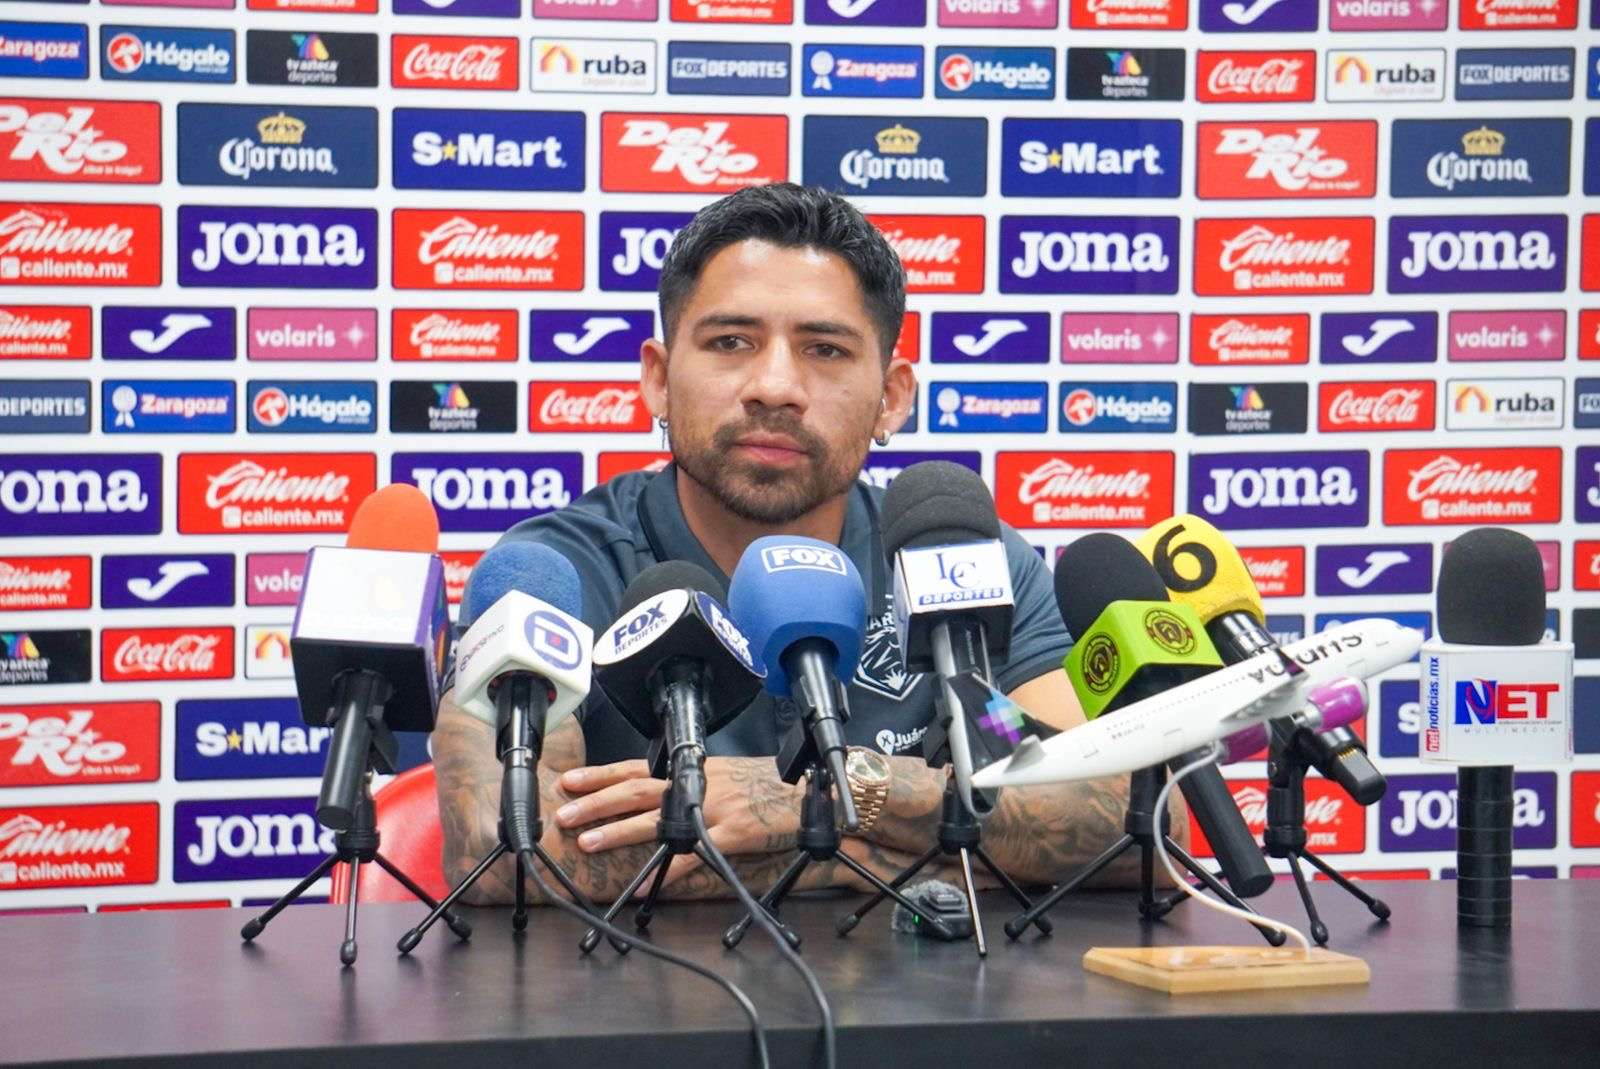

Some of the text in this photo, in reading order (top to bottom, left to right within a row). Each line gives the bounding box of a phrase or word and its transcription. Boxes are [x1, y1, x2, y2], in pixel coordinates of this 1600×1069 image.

[945, 0, 1021, 14] volaris
[1336, 0, 1410, 17] volaris
[144, 34, 229, 72] Hágalo
[584, 53, 646, 76] ruba
[287, 69, 337, 84] deportes
[707, 60, 787, 78] DEPORTES
[836, 59, 917, 83] Zaragoza
[973, 54, 1051, 90] Hágalo
[1375, 62, 1436, 84] ruba
[1494, 65, 1570, 83] DEPORTES
[617, 119, 731, 147] Del
[1215, 127, 1322, 155] Del
[218, 137, 338, 181] Corona
[839, 148, 950, 189] Corona
[1426, 151, 1533, 191] Corona
[417, 216, 560, 265] Caliente
[1219, 225, 1351, 272] Caliente
[21, 258, 128, 279] caliente.mx
[454, 264, 554, 284] caliente.mx
[1252, 271, 1344, 289] caliente.mx
[255, 324, 336, 348] volaris
[410, 313, 501, 346] Caliente
[1067, 328, 1142, 352] volaris
[1208, 319, 1294, 351] Caliente
[1455, 325, 1528, 349] volaris
[140, 394, 228, 419] Zaragoza
[289, 395, 371, 424] Hágalo
[962, 395, 1042, 418] Zaragoza
[1097, 396, 1172, 425] Hágalo
[1494, 391, 1555, 414] ruba
[428, 416, 477, 431] deportes
[1225, 419, 1271, 433] deportes
[0, 468, 148, 514] oma
[205, 459, 350, 509] Caliente
[1018, 457, 1150, 504] Caliente
[1406, 455, 1538, 503] Caliente
[241, 508, 345, 527] caliente.mx
[1051, 503, 1145, 521] caliente.mx
[1438, 501, 1533, 520] caliente.mx
[773, 546, 837, 570] FOX
[1153, 524, 1218, 593] 6
[254, 568, 303, 593] vola
[919, 587, 1004, 605] DEPORTES
[612, 600, 666, 648] FOX
[614, 616, 668, 656] DEPORTES
[1247, 632, 1363, 684] voaris
[1455, 678, 1560, 725] NET
[18, 860, 125, 881] caliente.mx
